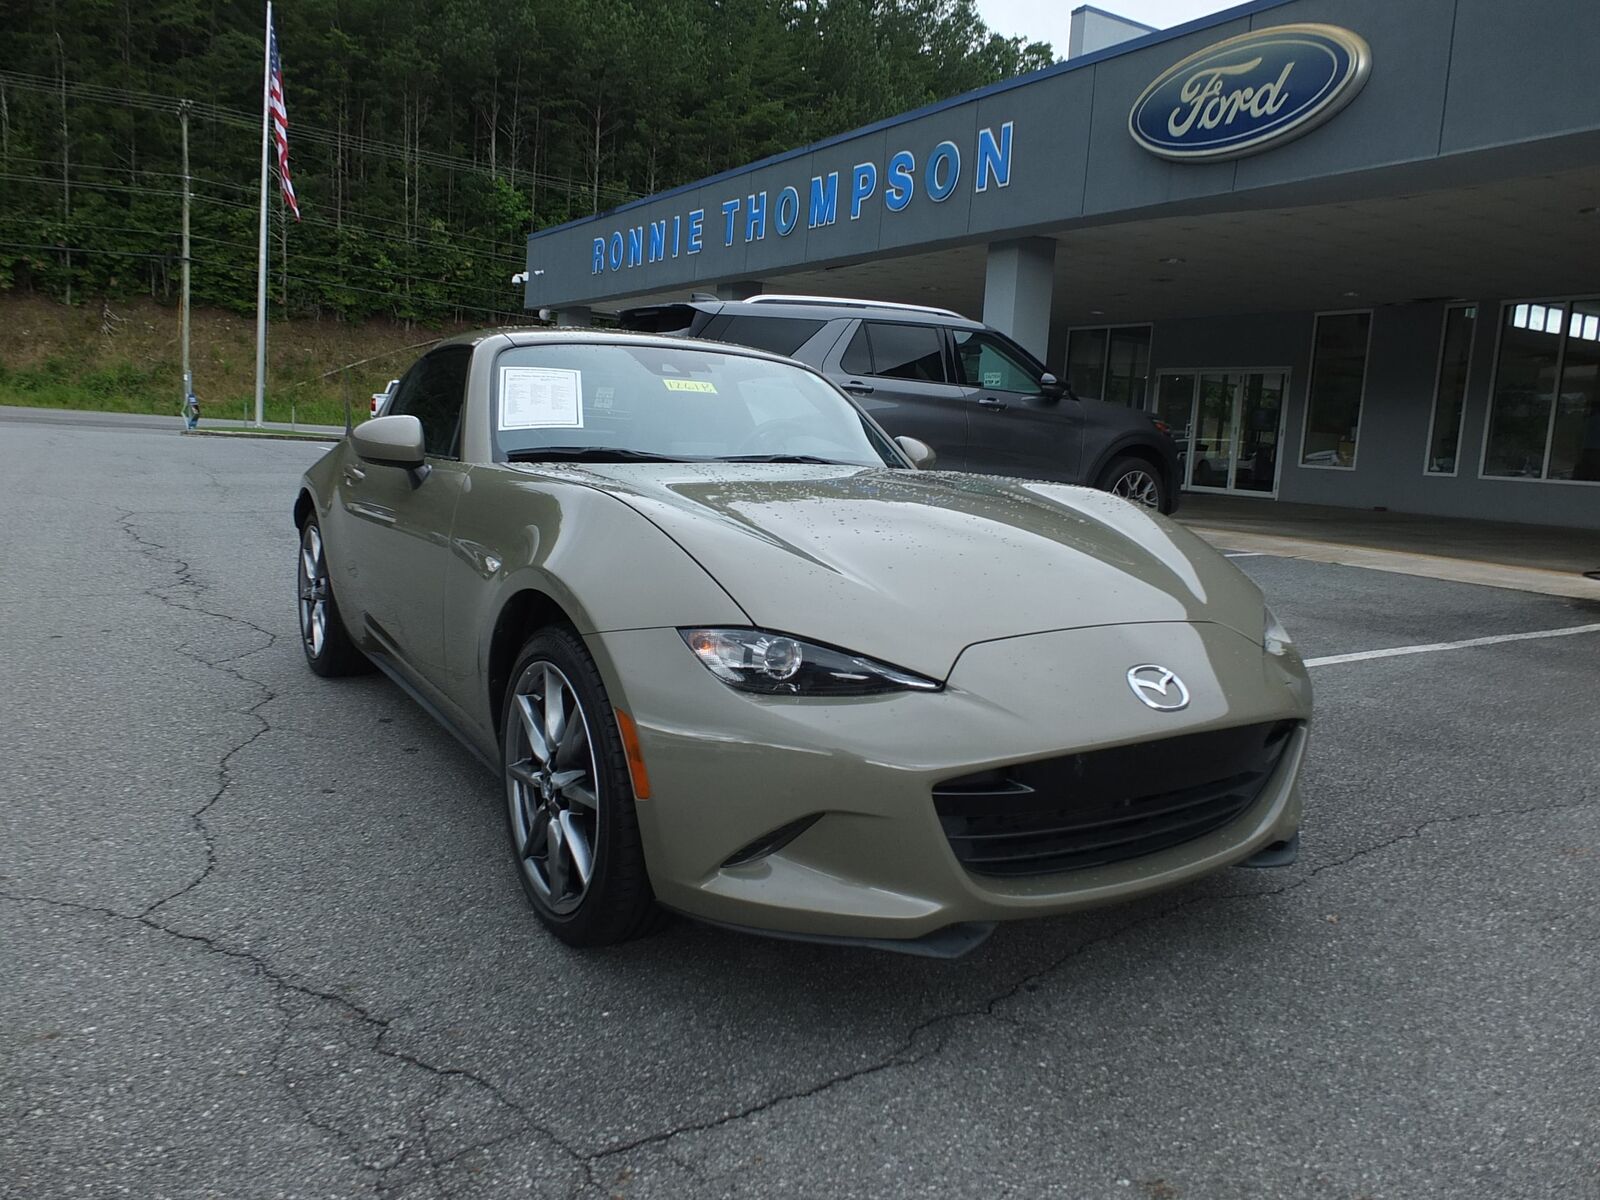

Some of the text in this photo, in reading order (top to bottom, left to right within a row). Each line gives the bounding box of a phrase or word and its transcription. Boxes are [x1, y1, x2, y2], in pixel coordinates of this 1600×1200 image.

[1167, 57, 1296, 137] Ford
[591, 121, 1014, 275] RONNIE THOMPSON
